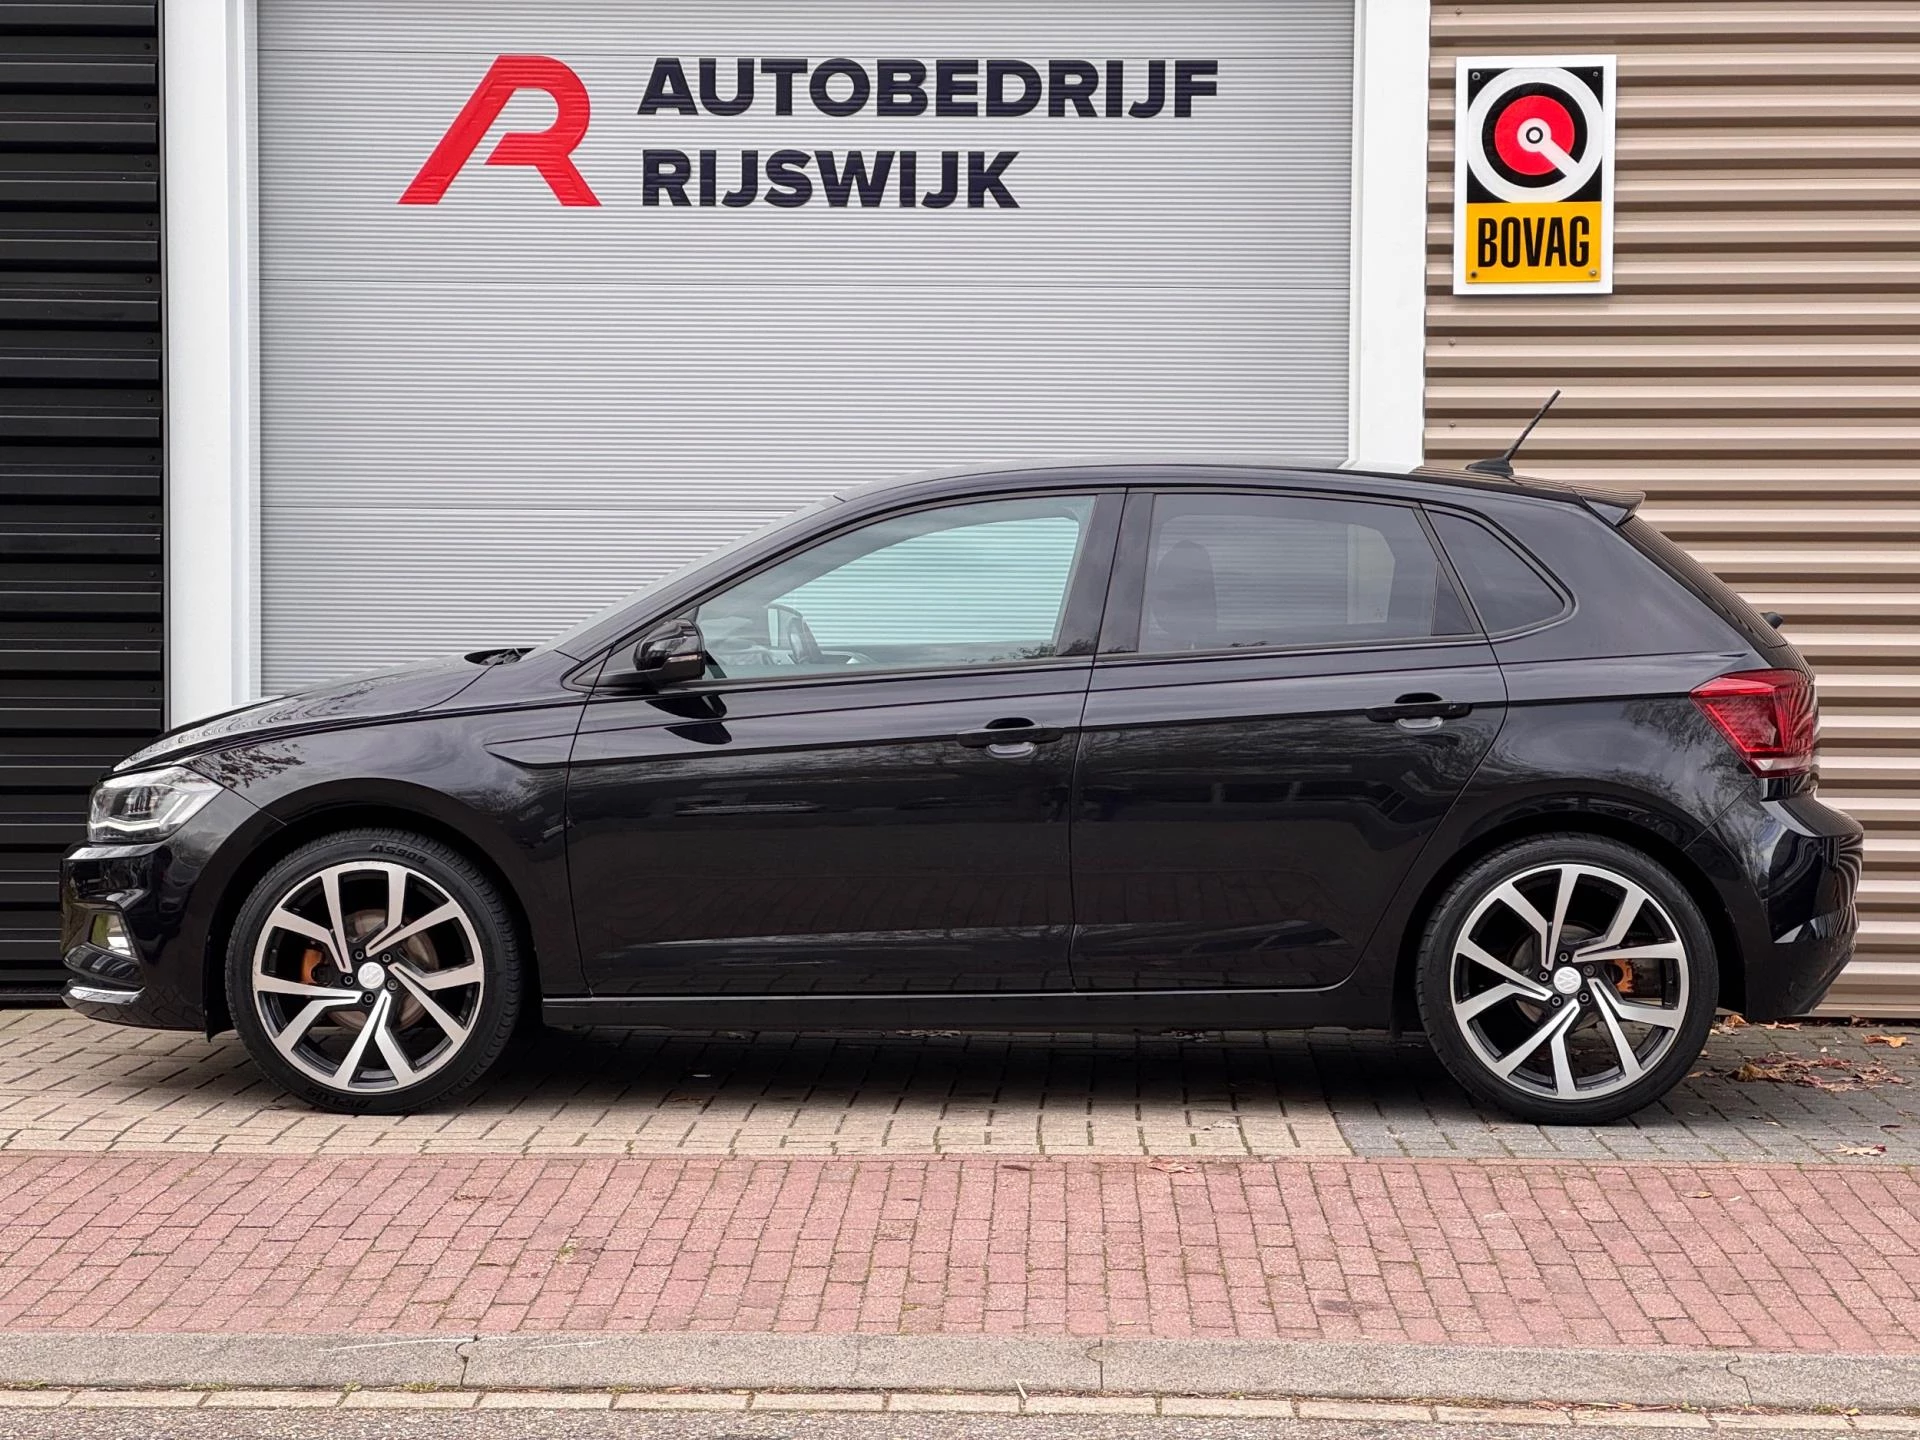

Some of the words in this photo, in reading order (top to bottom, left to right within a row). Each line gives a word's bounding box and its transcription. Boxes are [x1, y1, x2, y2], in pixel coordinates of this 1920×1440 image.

[637, 57, 1219, 119] AUTOBEDRIJF
[642, 149, 1021, 208] RIJSWIJK
[1477, 215, 1590, 269] BOVAG
